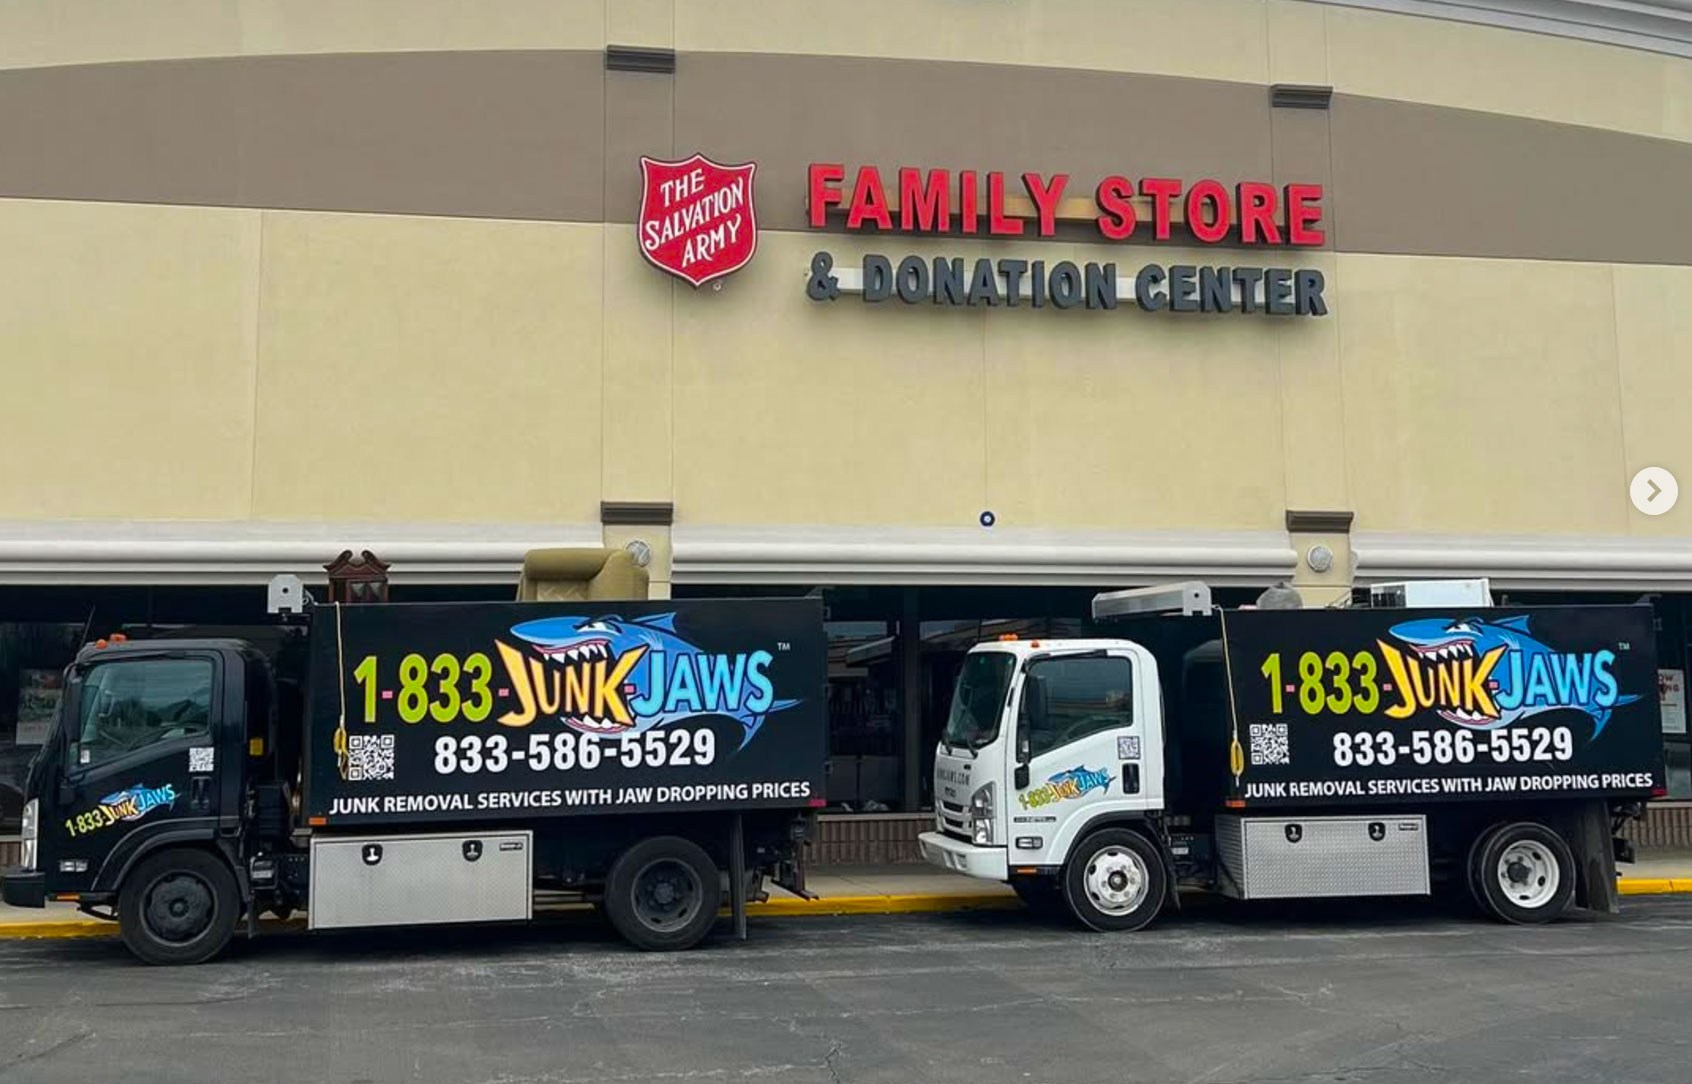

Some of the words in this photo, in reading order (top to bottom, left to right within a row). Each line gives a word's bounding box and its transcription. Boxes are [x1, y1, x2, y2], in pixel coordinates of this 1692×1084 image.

[660, 168, 706, 208] THE
[809, 164, 1069, 237] FAMILY
[1096, 176, 1325, 246] STORE
[644, 176, 743, 250] SALVATION
[682, 213, 742, 268] ARMY
[806, 251, 841, 301] &
[862, 254, 1117, 310] DONATION
[1136, 263, 1328, 316] CENTER
[434, 728, 716, 775] 833-586-5529
[1333, 727, 1573, 766] 833-586-5529
[329, 797, 380, 815] JUNK
[384, 793, 474, 812] REMOVAL
[477, 790, 562, 809] SERVICES
[565, 788, 612, 806] WITH
[615, 787, 653, 804] JAW
[657, 783, 748, 802] DROPPING
[752, 781, 811, 798] PRICES
[1245, 783, 1287, 798] JUNK
[1290, 780, 1366, 797] REMOVAL
[1368, 778, 1440, 795] SERVICES
[1441, 777, 1483, 793] WITH
[1485, 776, 1517, 792] JAW
[1520, 774, 1600, 791] DROPPING
[1602, 773, 1654, 789] PRICES
